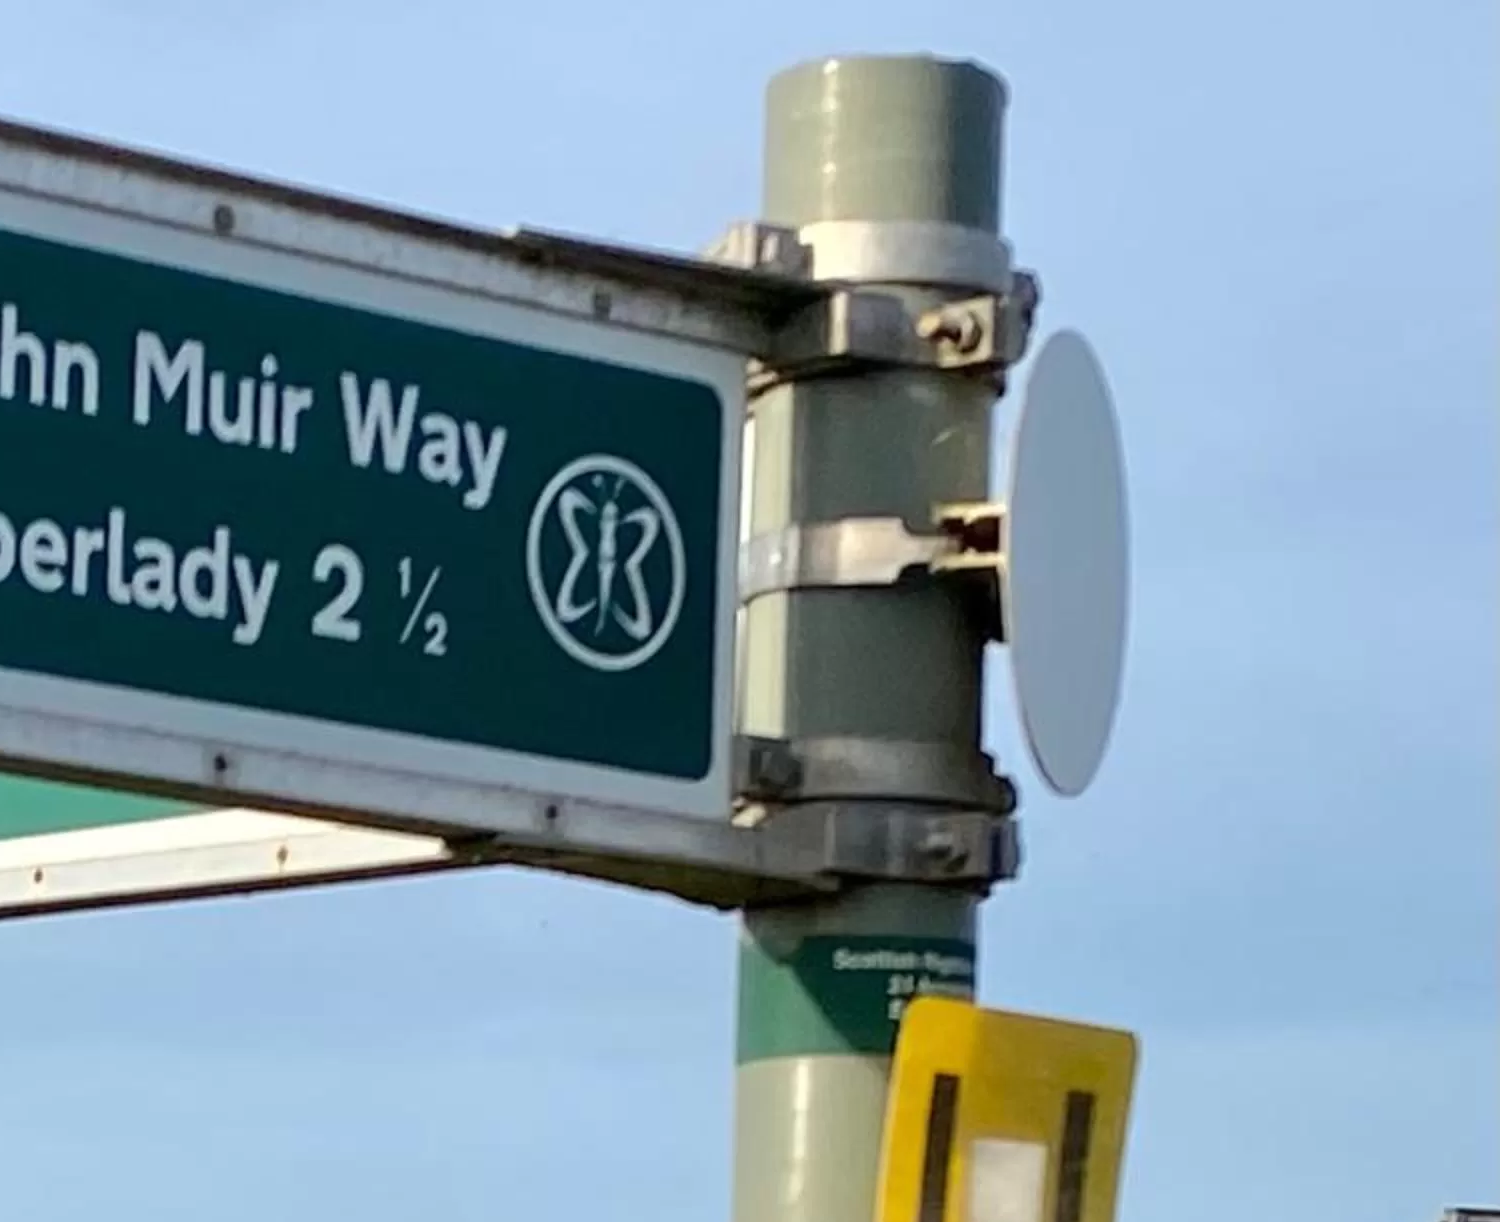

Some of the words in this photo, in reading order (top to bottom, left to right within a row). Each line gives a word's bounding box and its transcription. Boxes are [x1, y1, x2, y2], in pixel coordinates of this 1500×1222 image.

[133, 331, 313, 453] Muir
[340, 373, 507, 510] Way
[311, 544, 363, 641] 2
